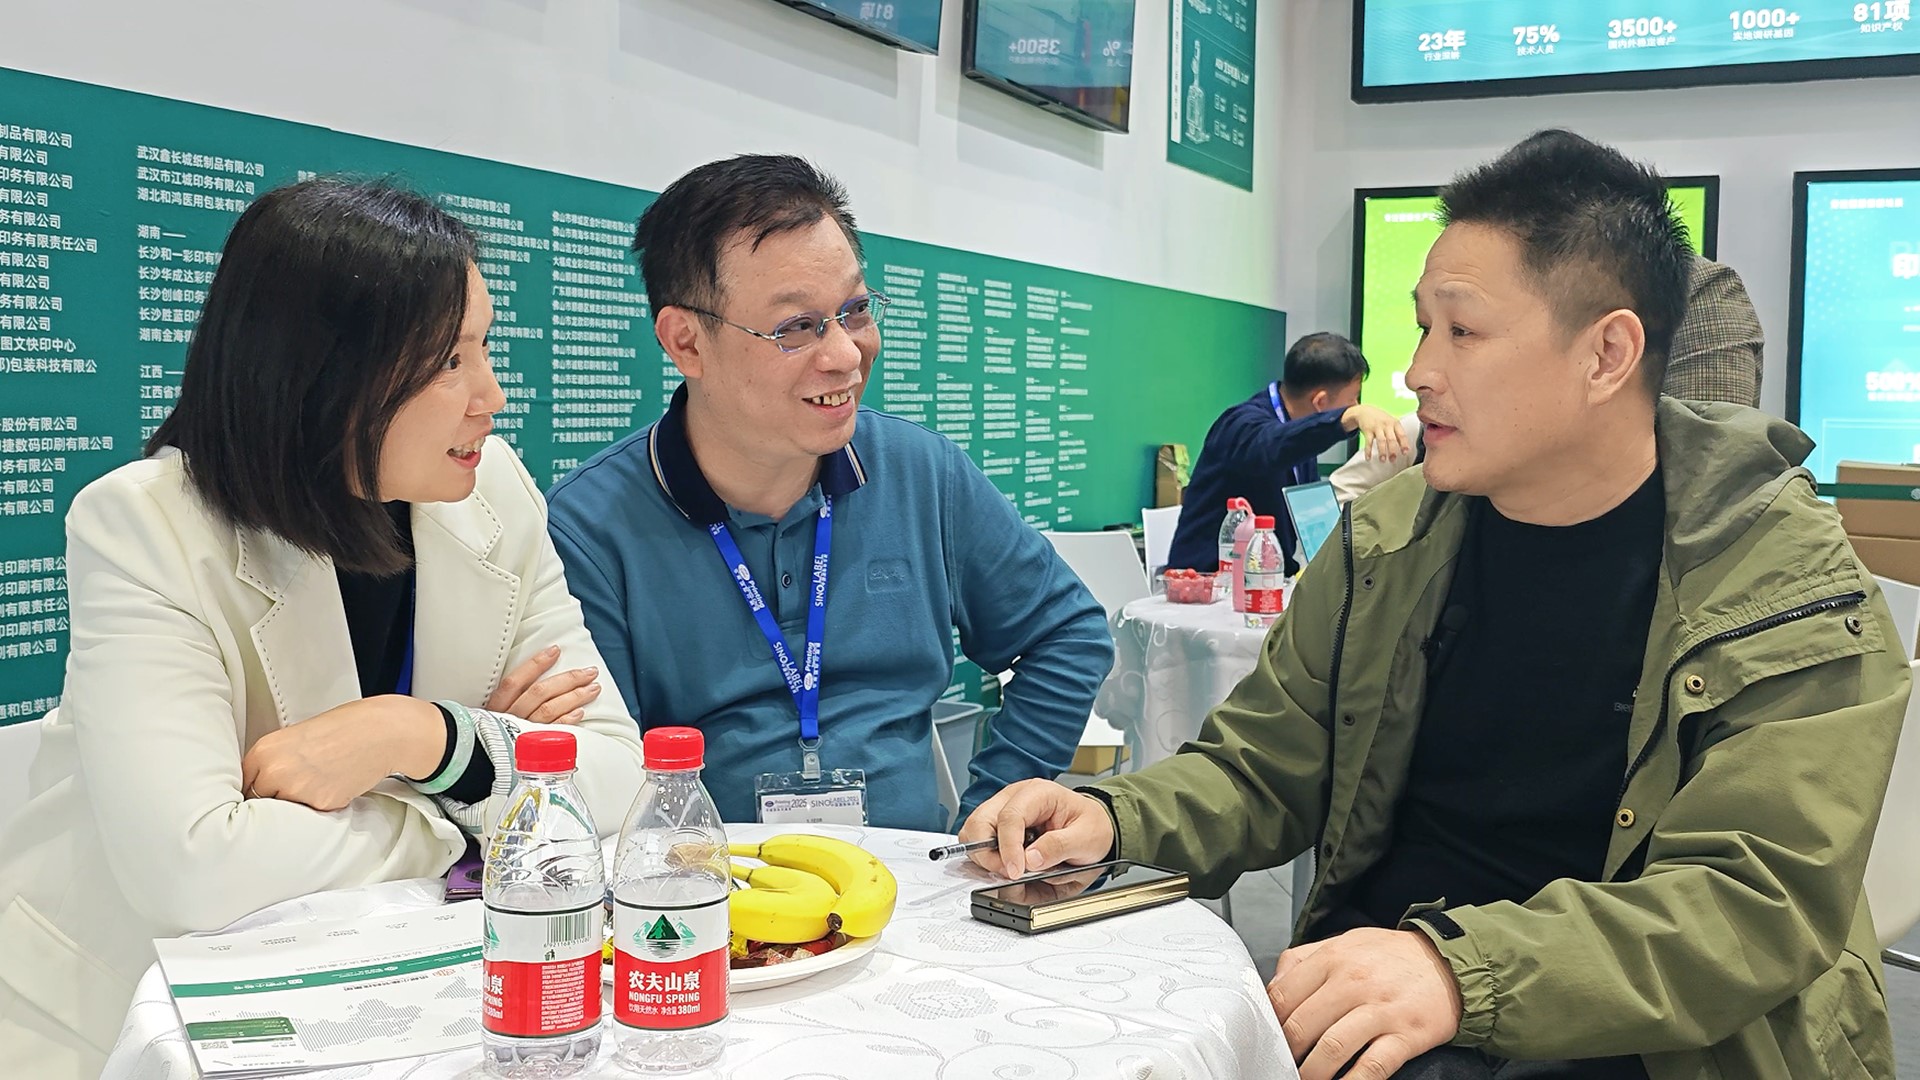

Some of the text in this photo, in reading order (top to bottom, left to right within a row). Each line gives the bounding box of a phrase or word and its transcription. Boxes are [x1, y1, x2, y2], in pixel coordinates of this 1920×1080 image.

[1729, 8, 1800, 30] 1000+
[1853, 0, 1911, 22] 81项
[1513, 24, 1560, 45] 75%
[1607, 16, 1678, 39] 3500+
[1418, 29, 1466, 51] 23年
[1516, 45, 1554, 56] 技术人员
[0, 188, 48, 207] 有限公司
[0, 251, 49, 269] 有限公司
[0, 272, 50, 290] 有限公司
[0, 293, 62, 311] 务有限公司
[139, 286, 210, 304] 长沙创峰印务
[0, 315, 51, 331] 有限公司
[0, 417, 77, 432] 股份有限公司
[0, 436, 113, 453] 捷数码印刷有限公司
[0, 458, 66, 474] 务有限公司
[0, 479, 54, 495] 有限公司
[0, 499, 54, 516] 有限公司
[629, 969, 700, 992] 农夫山泉
[629, 991, 700, 1004] NONGFU SPRING
[678, 1003, 700, 1015] 380ml
